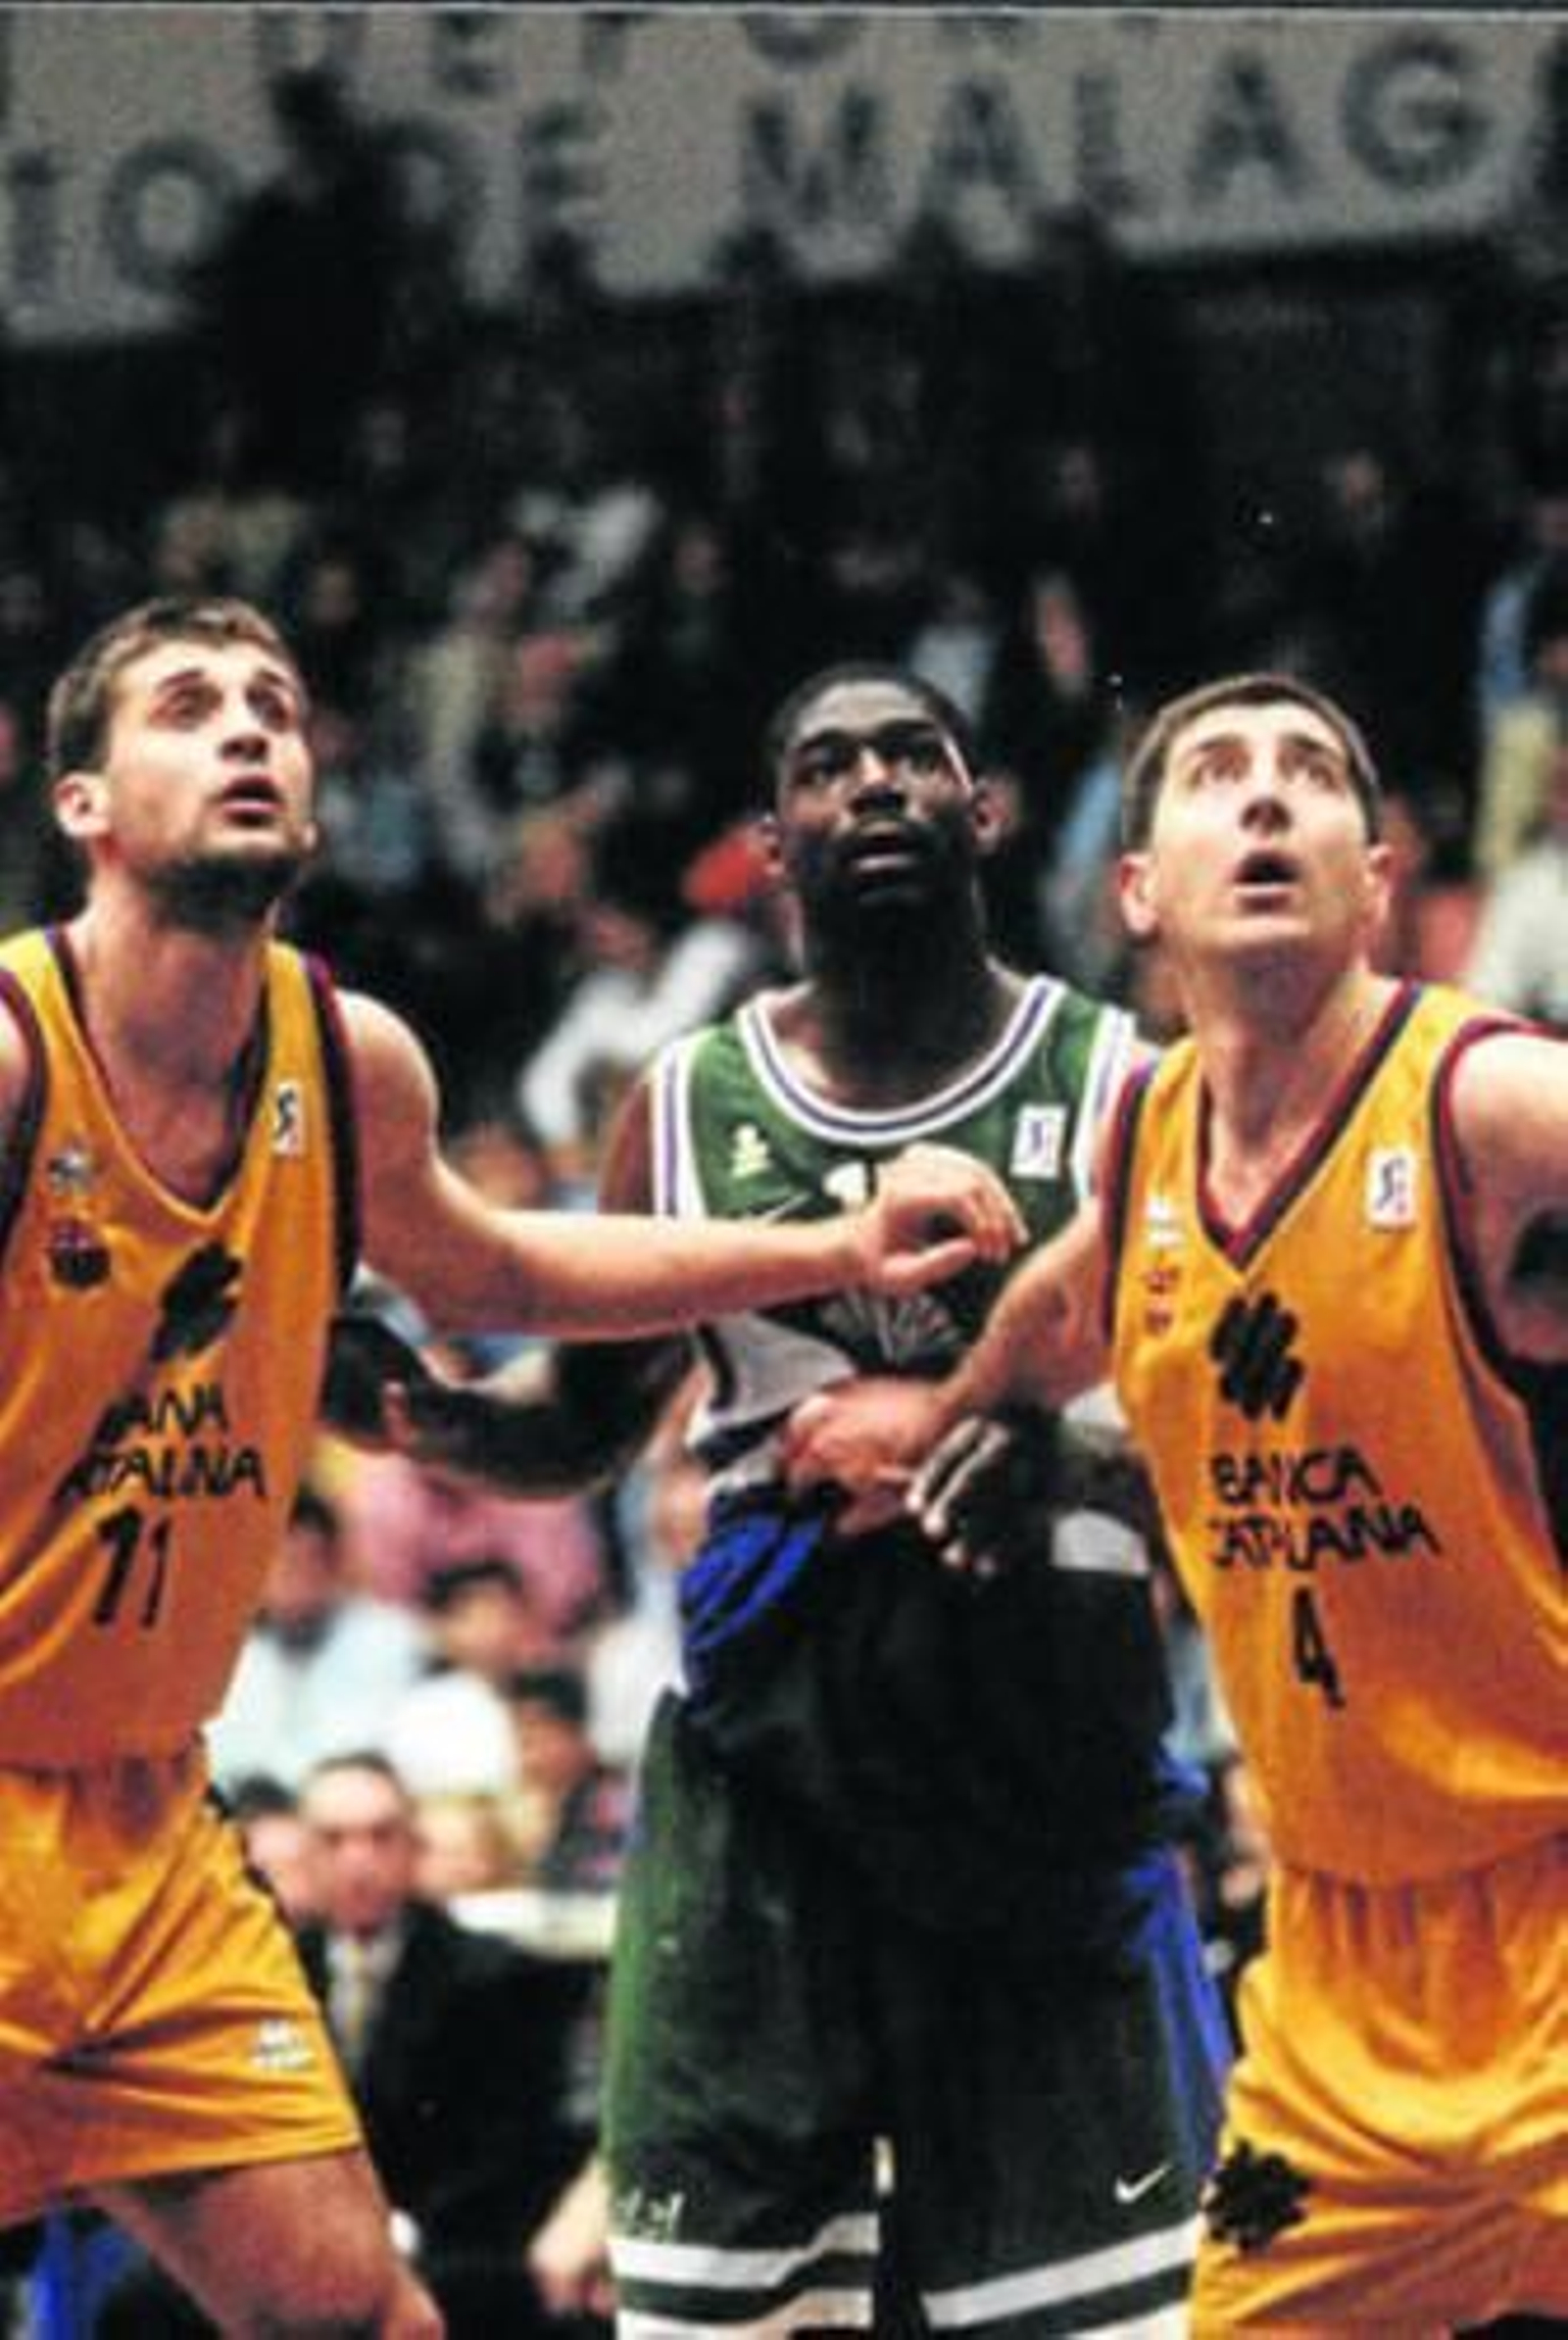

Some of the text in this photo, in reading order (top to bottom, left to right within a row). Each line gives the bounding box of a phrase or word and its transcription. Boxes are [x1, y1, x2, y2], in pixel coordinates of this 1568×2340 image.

[735, 31, 1568, 233] MALAG
[93, 1505, 172, 1629] 11
[1292, 1584, 1347, 1710] 4
